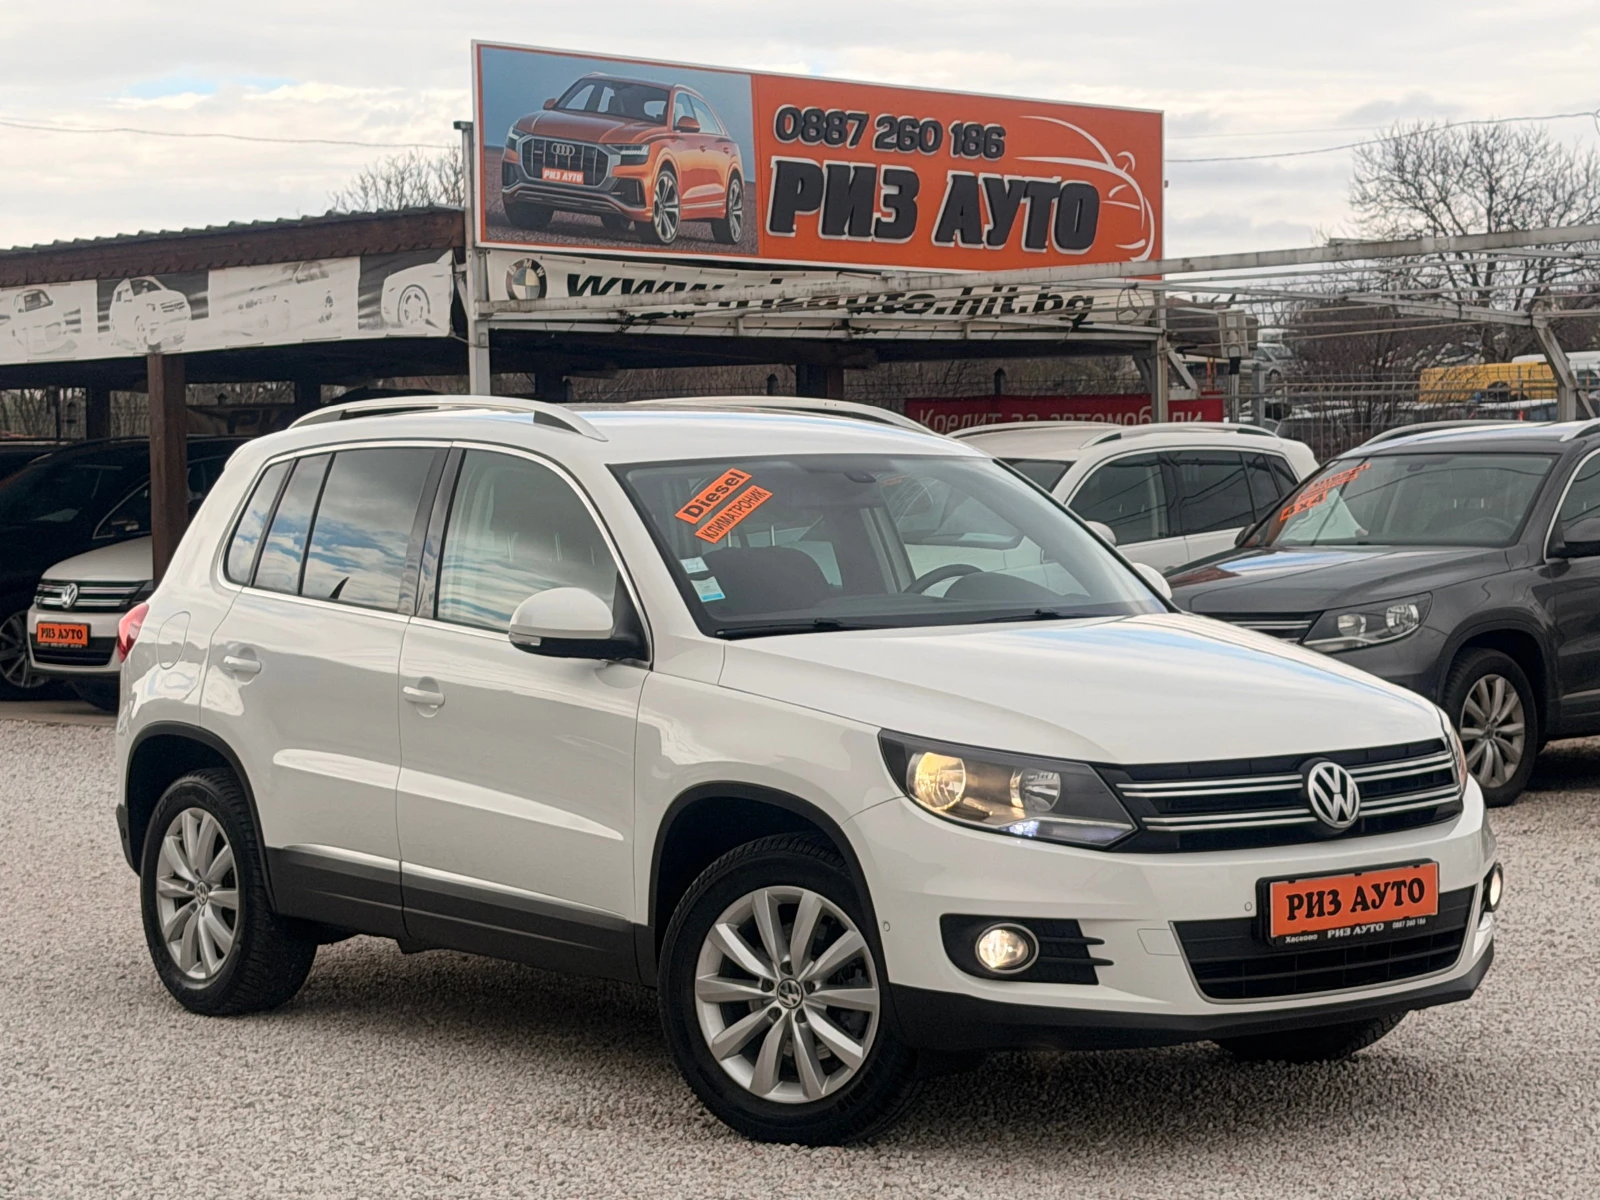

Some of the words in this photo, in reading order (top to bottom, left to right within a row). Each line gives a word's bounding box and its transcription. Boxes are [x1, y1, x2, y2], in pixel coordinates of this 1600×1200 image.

[774, 105, 869, 148] 0887
[873, 114, 943, 154] 260
[949, 120, 1006, 159] 186
[766, 156, 920, 243] РИЗ
[931, 171, 1100, 254] АУТО
[684, 472, 745, 518] Diesel
[701, 487, 767, 539] КЛИМАТРОНИК
[58, 628, 83, 640] АУТО
[1286, 889, 1342, 921] РИЗ
[1350, 878, 1425, 913] АУТО
[1327, 927, 1351, 939] РИЗ
[1353, 923, 1384, 936] АУТО
